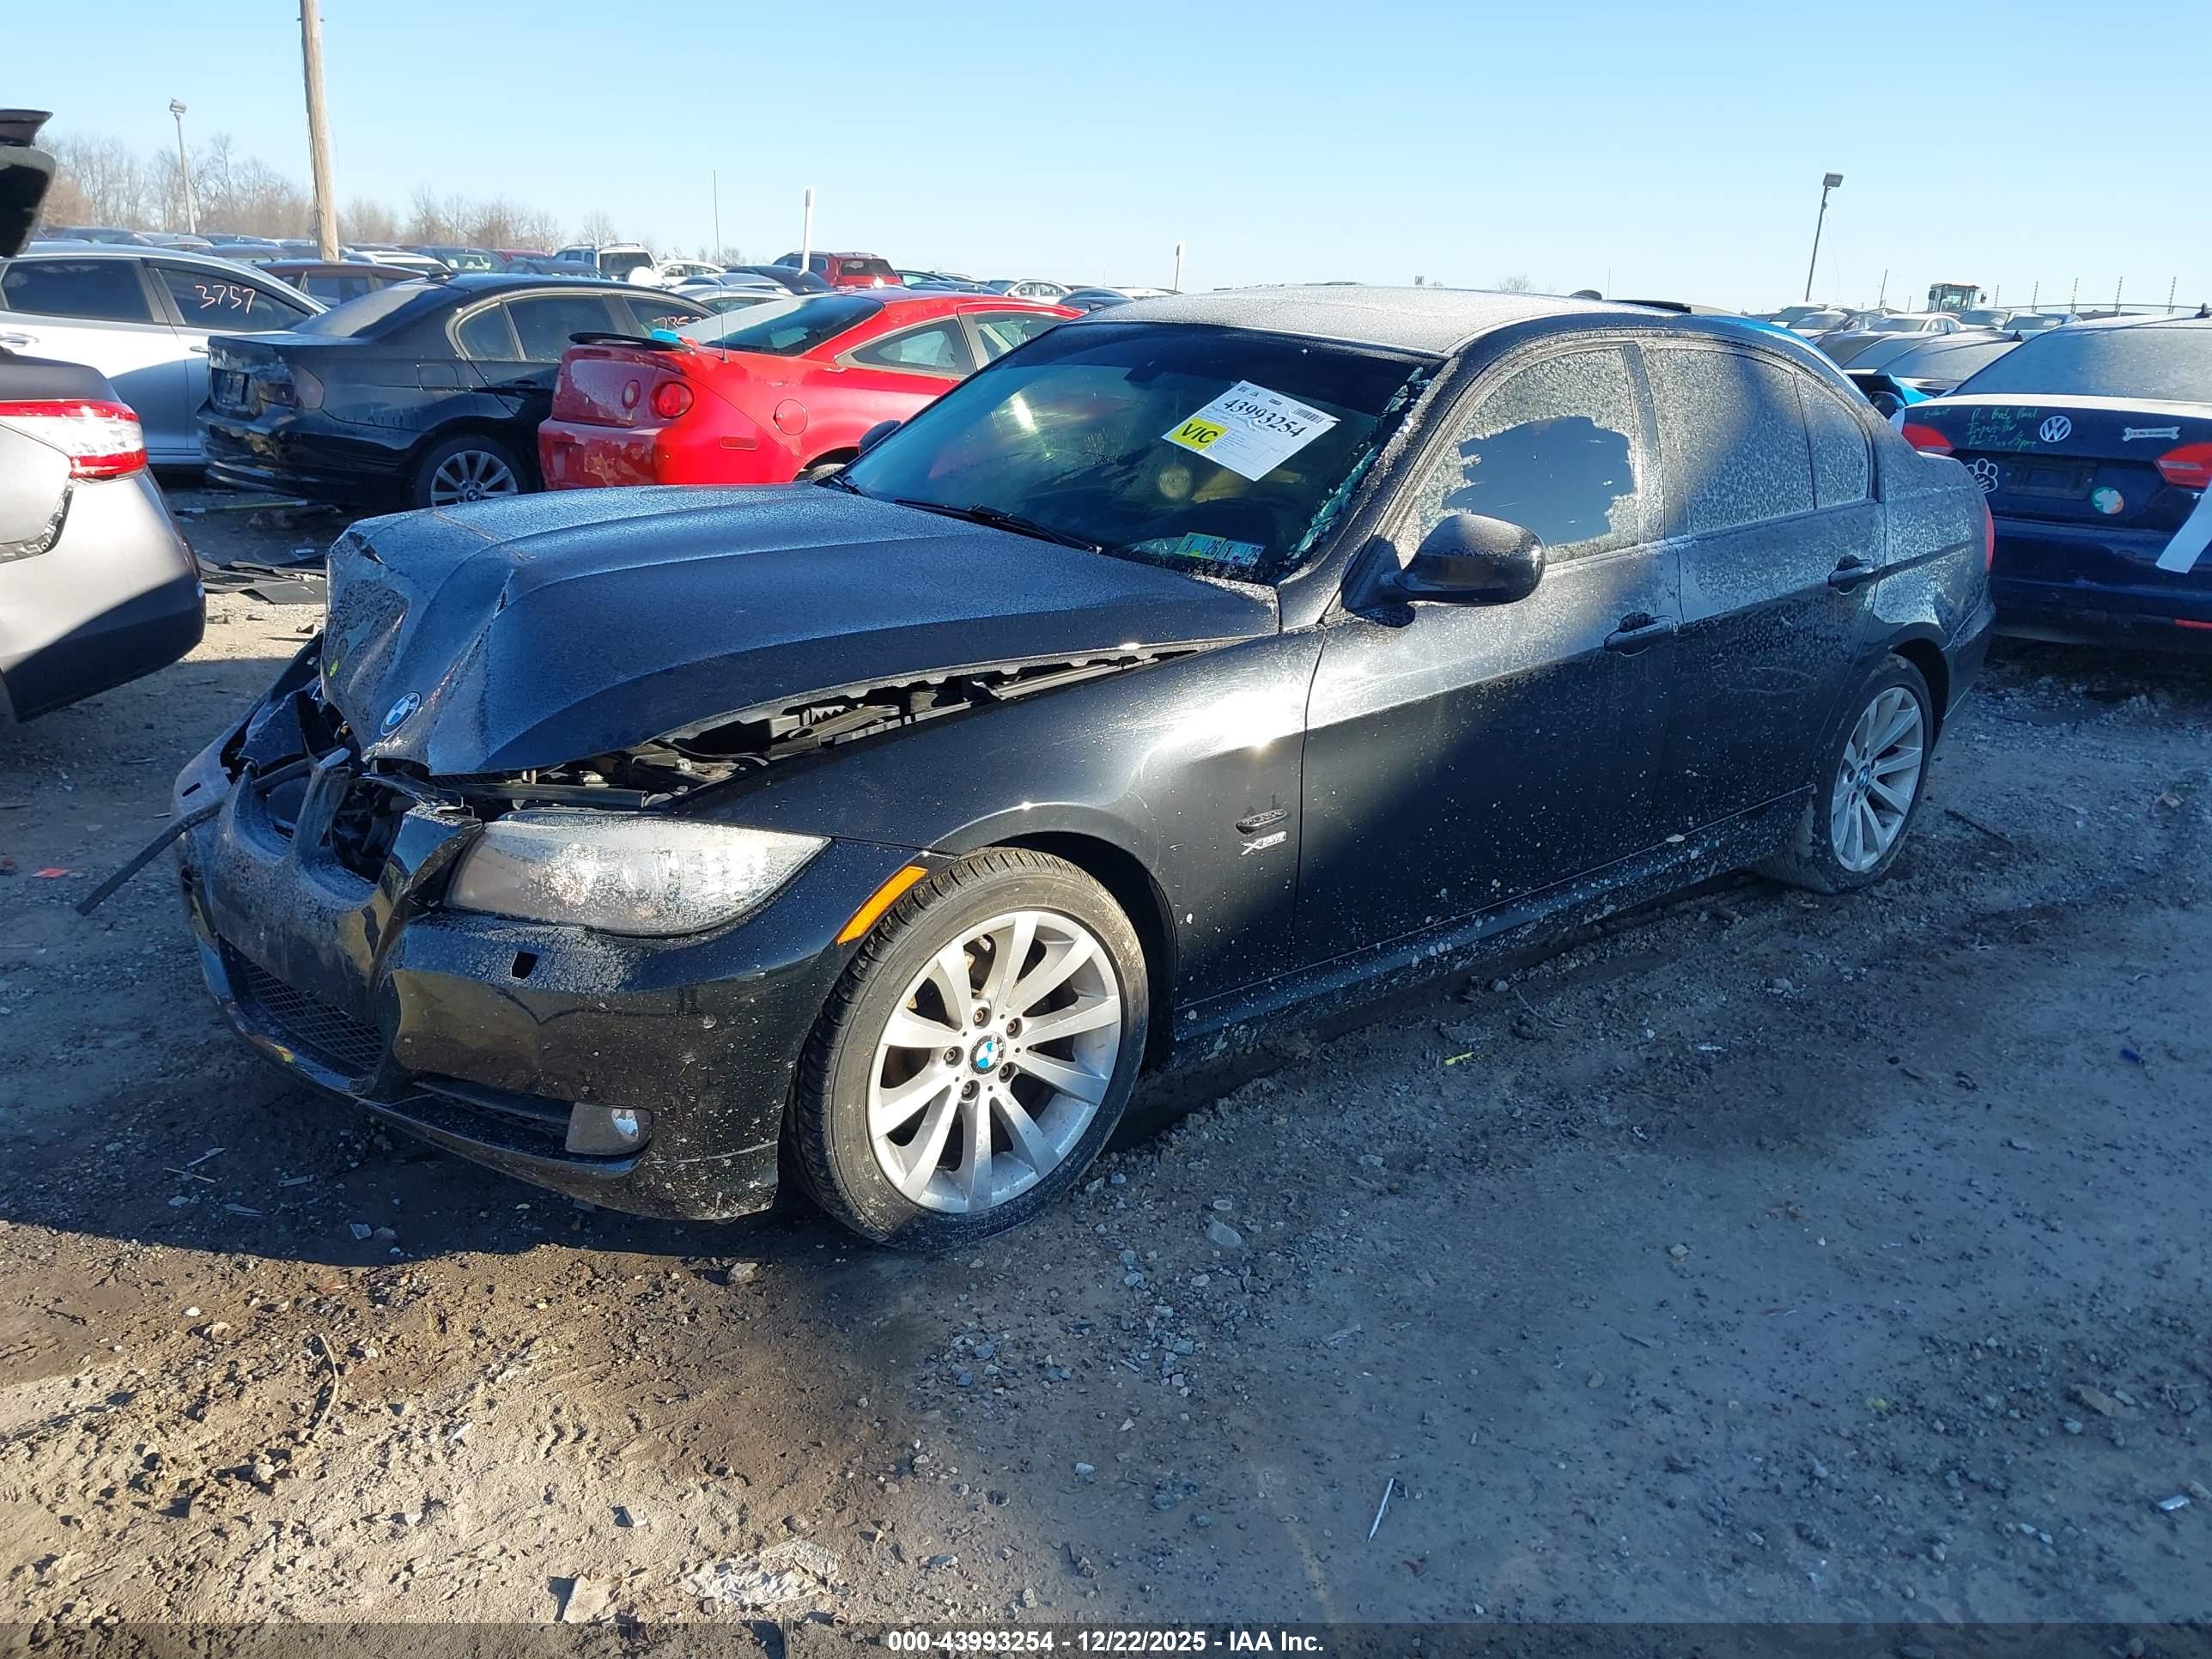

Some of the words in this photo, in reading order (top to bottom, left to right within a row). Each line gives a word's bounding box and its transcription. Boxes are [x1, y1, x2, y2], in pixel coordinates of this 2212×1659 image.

[194, 284, 257, 315] 3757
[1224, 398, 1309, 438] 43993254
[1181, 423, 1218, 444] VIC
[1205, 539, 1222, 556] 26
